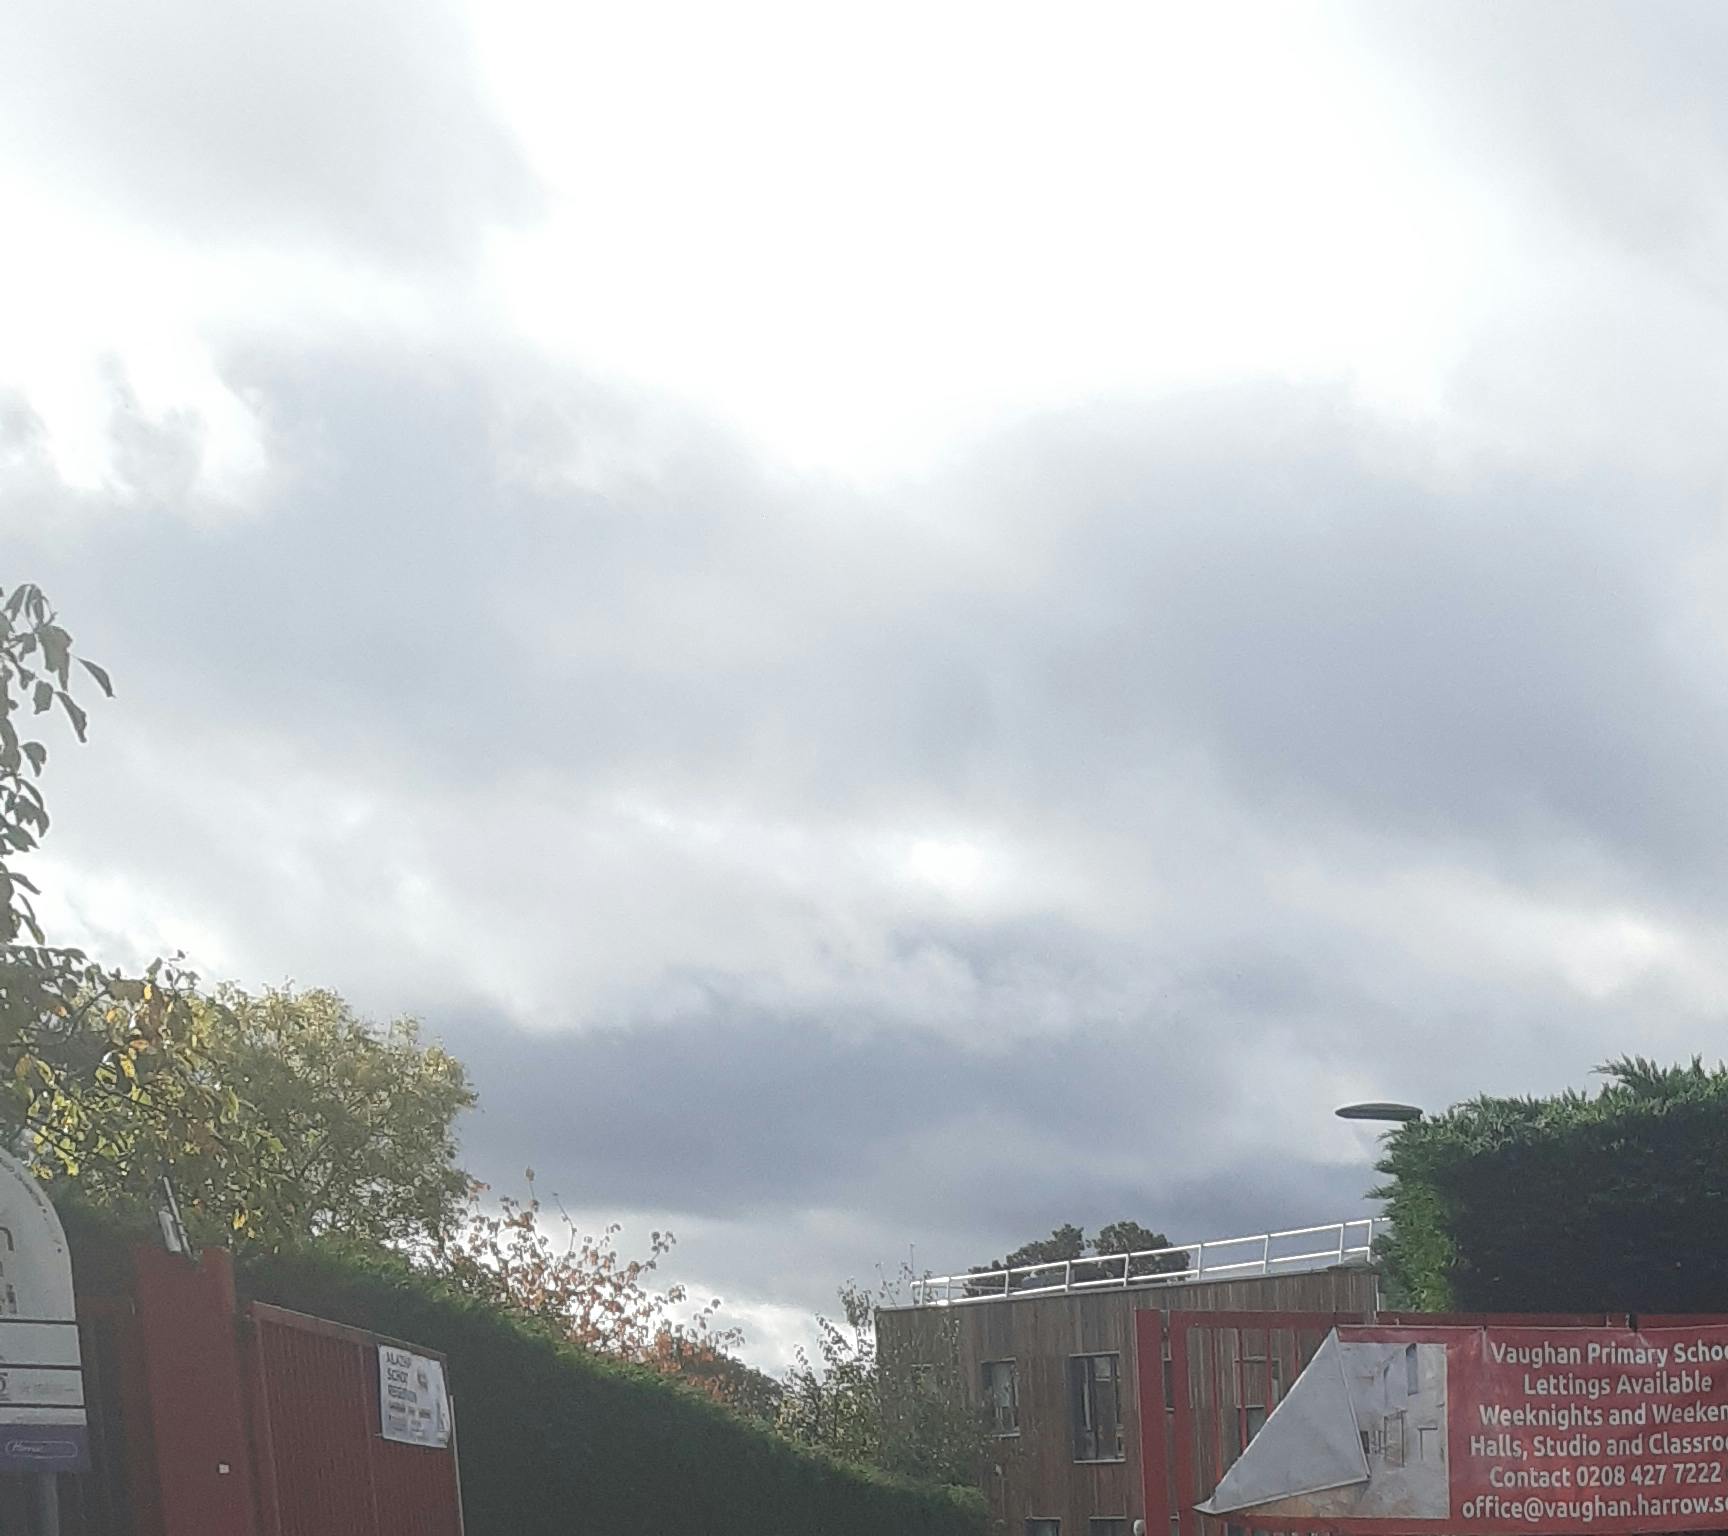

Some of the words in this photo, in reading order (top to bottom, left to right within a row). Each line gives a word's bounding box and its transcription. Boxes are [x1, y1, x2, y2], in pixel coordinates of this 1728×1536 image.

[1490, 1342, 1581, 1369] Vaughan
[1587, 1342, 1668, 1368] Primary
[1524, 1373, 1611, 1400] Lettings
[1616, 1370, 1712, 1395] Available
[1479, 1403, 1603, 1430] Weeknights
[1609, 1403, 1646, 1426] and
[1470, 1435, 1528, 1461] Halls,
[1533, 1434, 1600, 1457] Studio
[1607, 1434, 1643, 1456] and
[1489, 1467, 1571, 1488] Contact
[1576, 1465, 1625, 1487] 0208
[1630, 1464, 1666, 1486] 427
[1672, 1462, 1722, 1484] 7222
